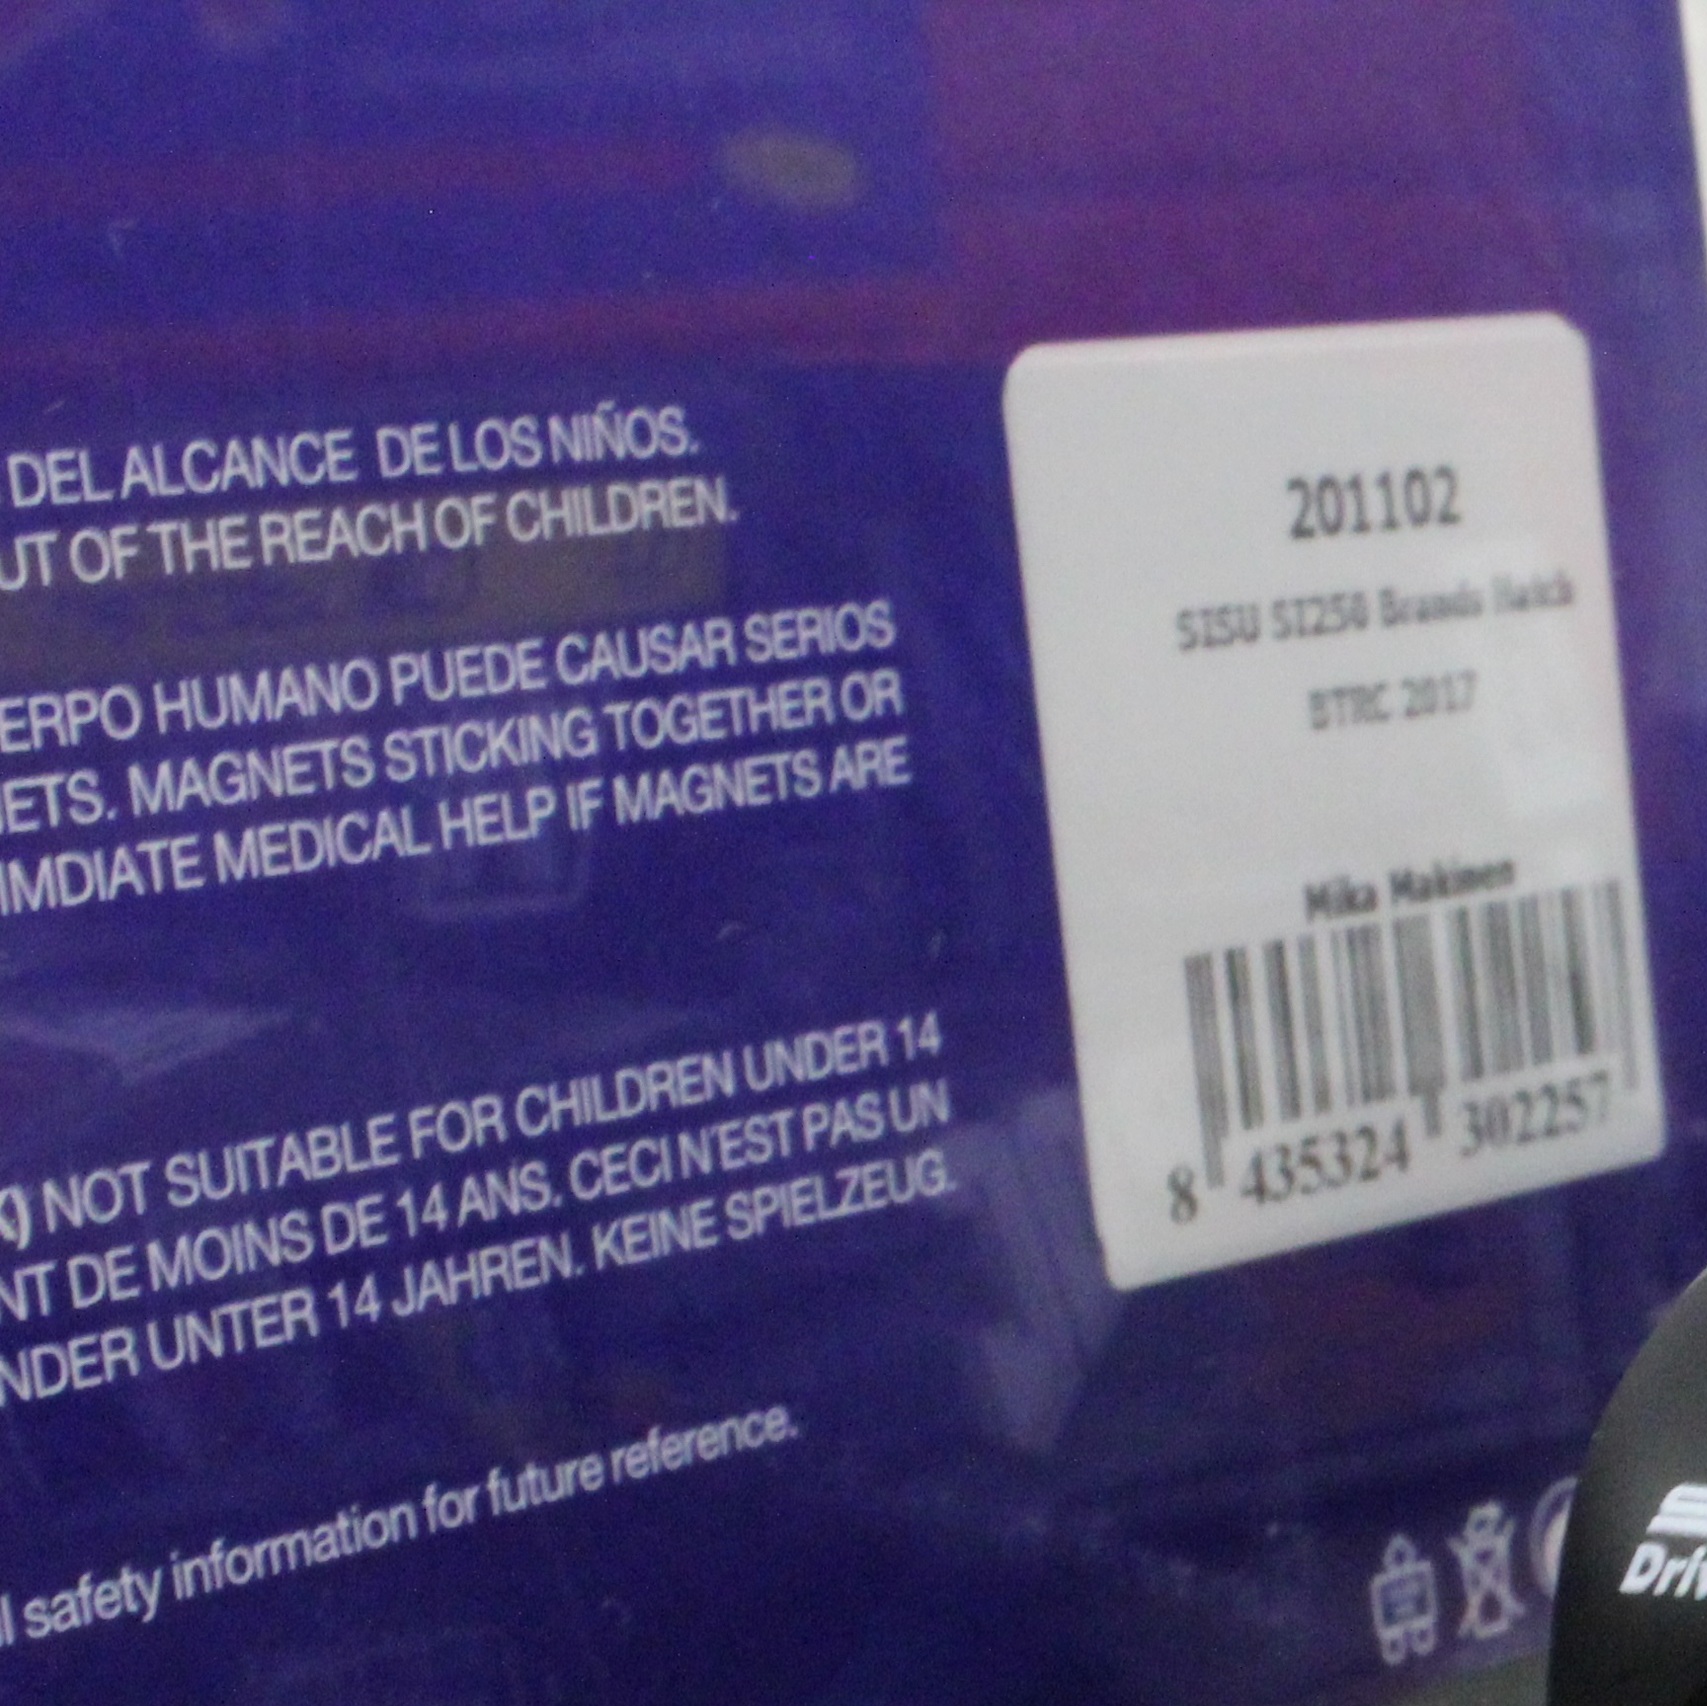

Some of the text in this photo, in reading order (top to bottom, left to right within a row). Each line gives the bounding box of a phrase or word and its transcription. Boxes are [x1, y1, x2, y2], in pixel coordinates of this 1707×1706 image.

[8, 402, 698, 508] DEL ALCANCE DE LOS NIÑOS.
[1287, 464, 1460, 538] 201102
[70, 520, 139, 584] OF
[148, 510, 252, 575] THE
[260, 495, 426, 565] REACH
[435, 491, 498, 547] OF
[506, 477, 738, 541] CHILDREN.
[154, 659, 379, 733] HUMANO
[391, 639, 545, 705] PUEDE
[556, 616, 736, 684] CAUSAR
[745, 598, 894, 662] SERIOS
[1177, 602, 1260, 652] SISU
[127, 737, 373, 813] MAGNETS
[385, 705, 595, 781] STICKING
[604, 680, 836, 750] TOGETHER
[842, 668, 904, 721] OR
[1308, 669, 1476, 730] BTRC 2017
[213, 807, 430, 881] MEDICAL
[440, 788, 556, 850] HELP
[568, 784, 602, 830] IF
[615, 748, 820, 825] MAGNETS
[830, 737, 912, 794] ARE
[1304, 875, 1378, 922] Mika
[45, 1161, 148, 1235] NOT
[166, 1112, 398, 1208] SUITABLE
[409, 1093, 508, 1161] FOR
[516, 1054, 736, 1138] CHILDREN
[745, 1022, 887, 1097] UNDER
[897, 1011, 941, 1058] 14
[1166, 1070, 1608, 1224] 8 435324 302257
[69, 1249, 139, 1311] DE
[148, 1210, 314, 1291] MOINS
[324, 1196, 387, 1256] DE
[398, 1187, 448, 1239] 14
[457, 1163, 561, 1229] ANS.
[569, 1141, 672, 1202] CECI
[802, 1096, 883, 1153] PAS
[891, 1079, 949, 1131] UN
[148, 1286, 318, 1372] UNTER
[328, 1277, 381, 1327] 14
[392, 1234, 584, 1317] JAHREN.
[594, 1202, 719, 1272] KEINE
[727, 1148, 955, 1239] SPIELZEUG.
[25, 1561, 164, 1639] safety
[170, 1501, 416, 1600] information
[423, 1481, 478, 1532] for
[488, 1454, 604, 1519] future
[612, 1403, 798, 1481] reference.
